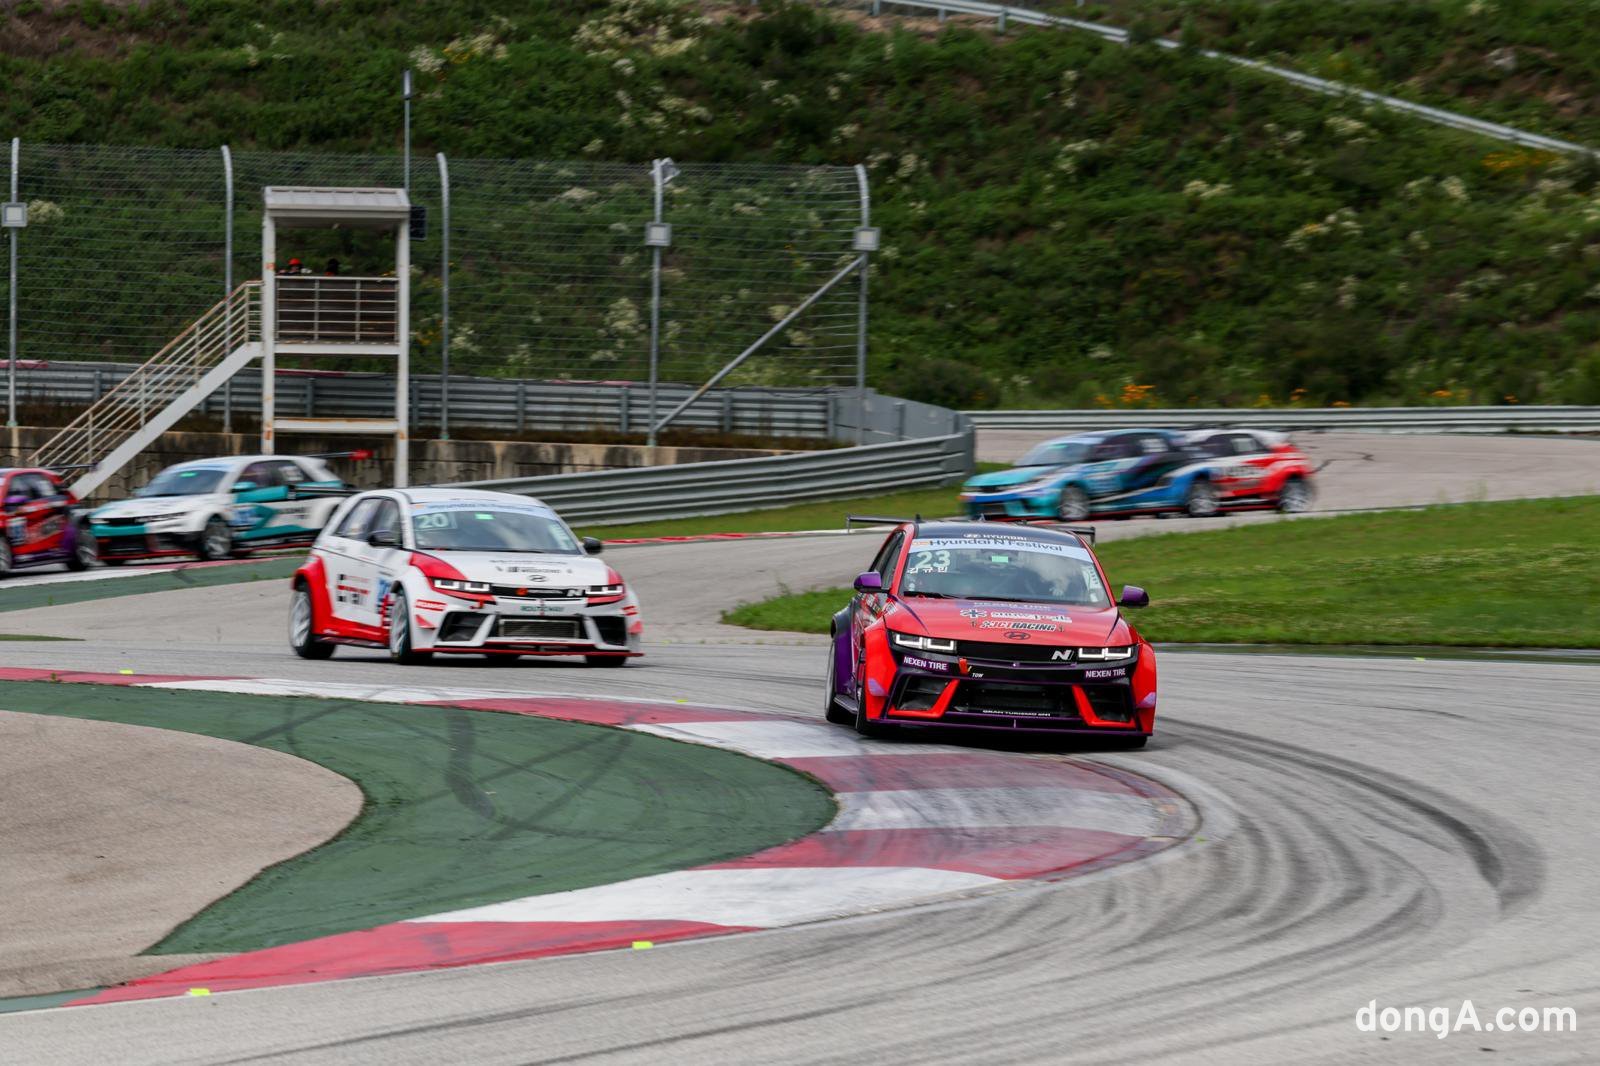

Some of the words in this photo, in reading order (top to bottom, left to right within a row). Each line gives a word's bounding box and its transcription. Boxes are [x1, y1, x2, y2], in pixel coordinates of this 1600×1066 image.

[417, 513, 450, 529] 20
[1007, 541, 1062, 552] Festival
[915, 550, 950, 568] 23
[903, 656, 927, 669] NEXEN
[928, 661, 947, 671] TIRE
[1085, 669, 1111, 678] NEXEN
[1113, 668, 1126, 676] TIRE
